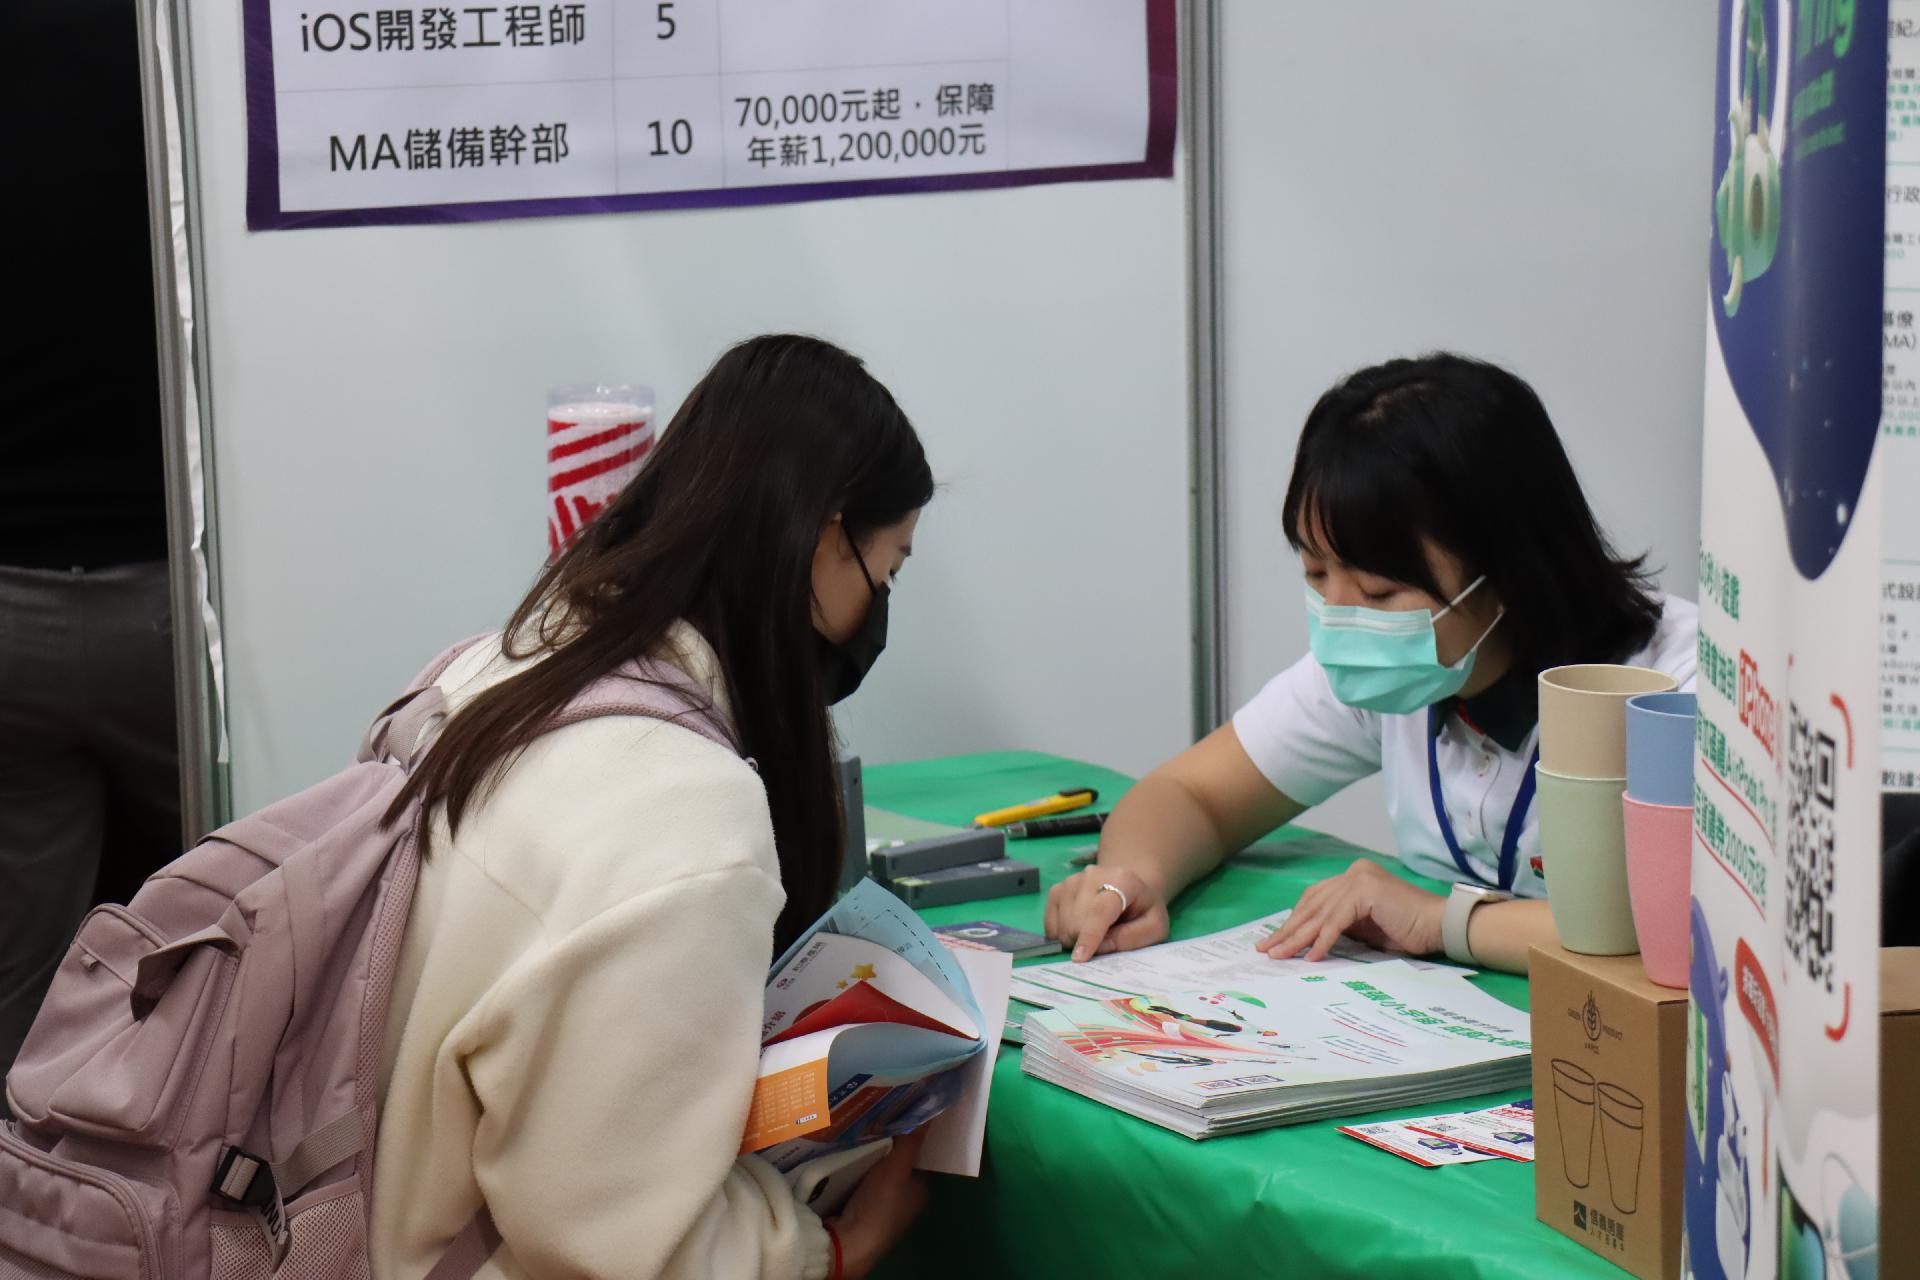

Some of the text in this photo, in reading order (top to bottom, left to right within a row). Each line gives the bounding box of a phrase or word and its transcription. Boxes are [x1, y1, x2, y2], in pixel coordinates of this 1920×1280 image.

[300, 4, 585, 52] iOS開發工程師
[657, 3, 676, 40] 5
[330, 123, 569, 172] MA儲備幹部
[648, 119, 693, 156] 10
[747, 123, 986, 168] 年薪1,200,000元
